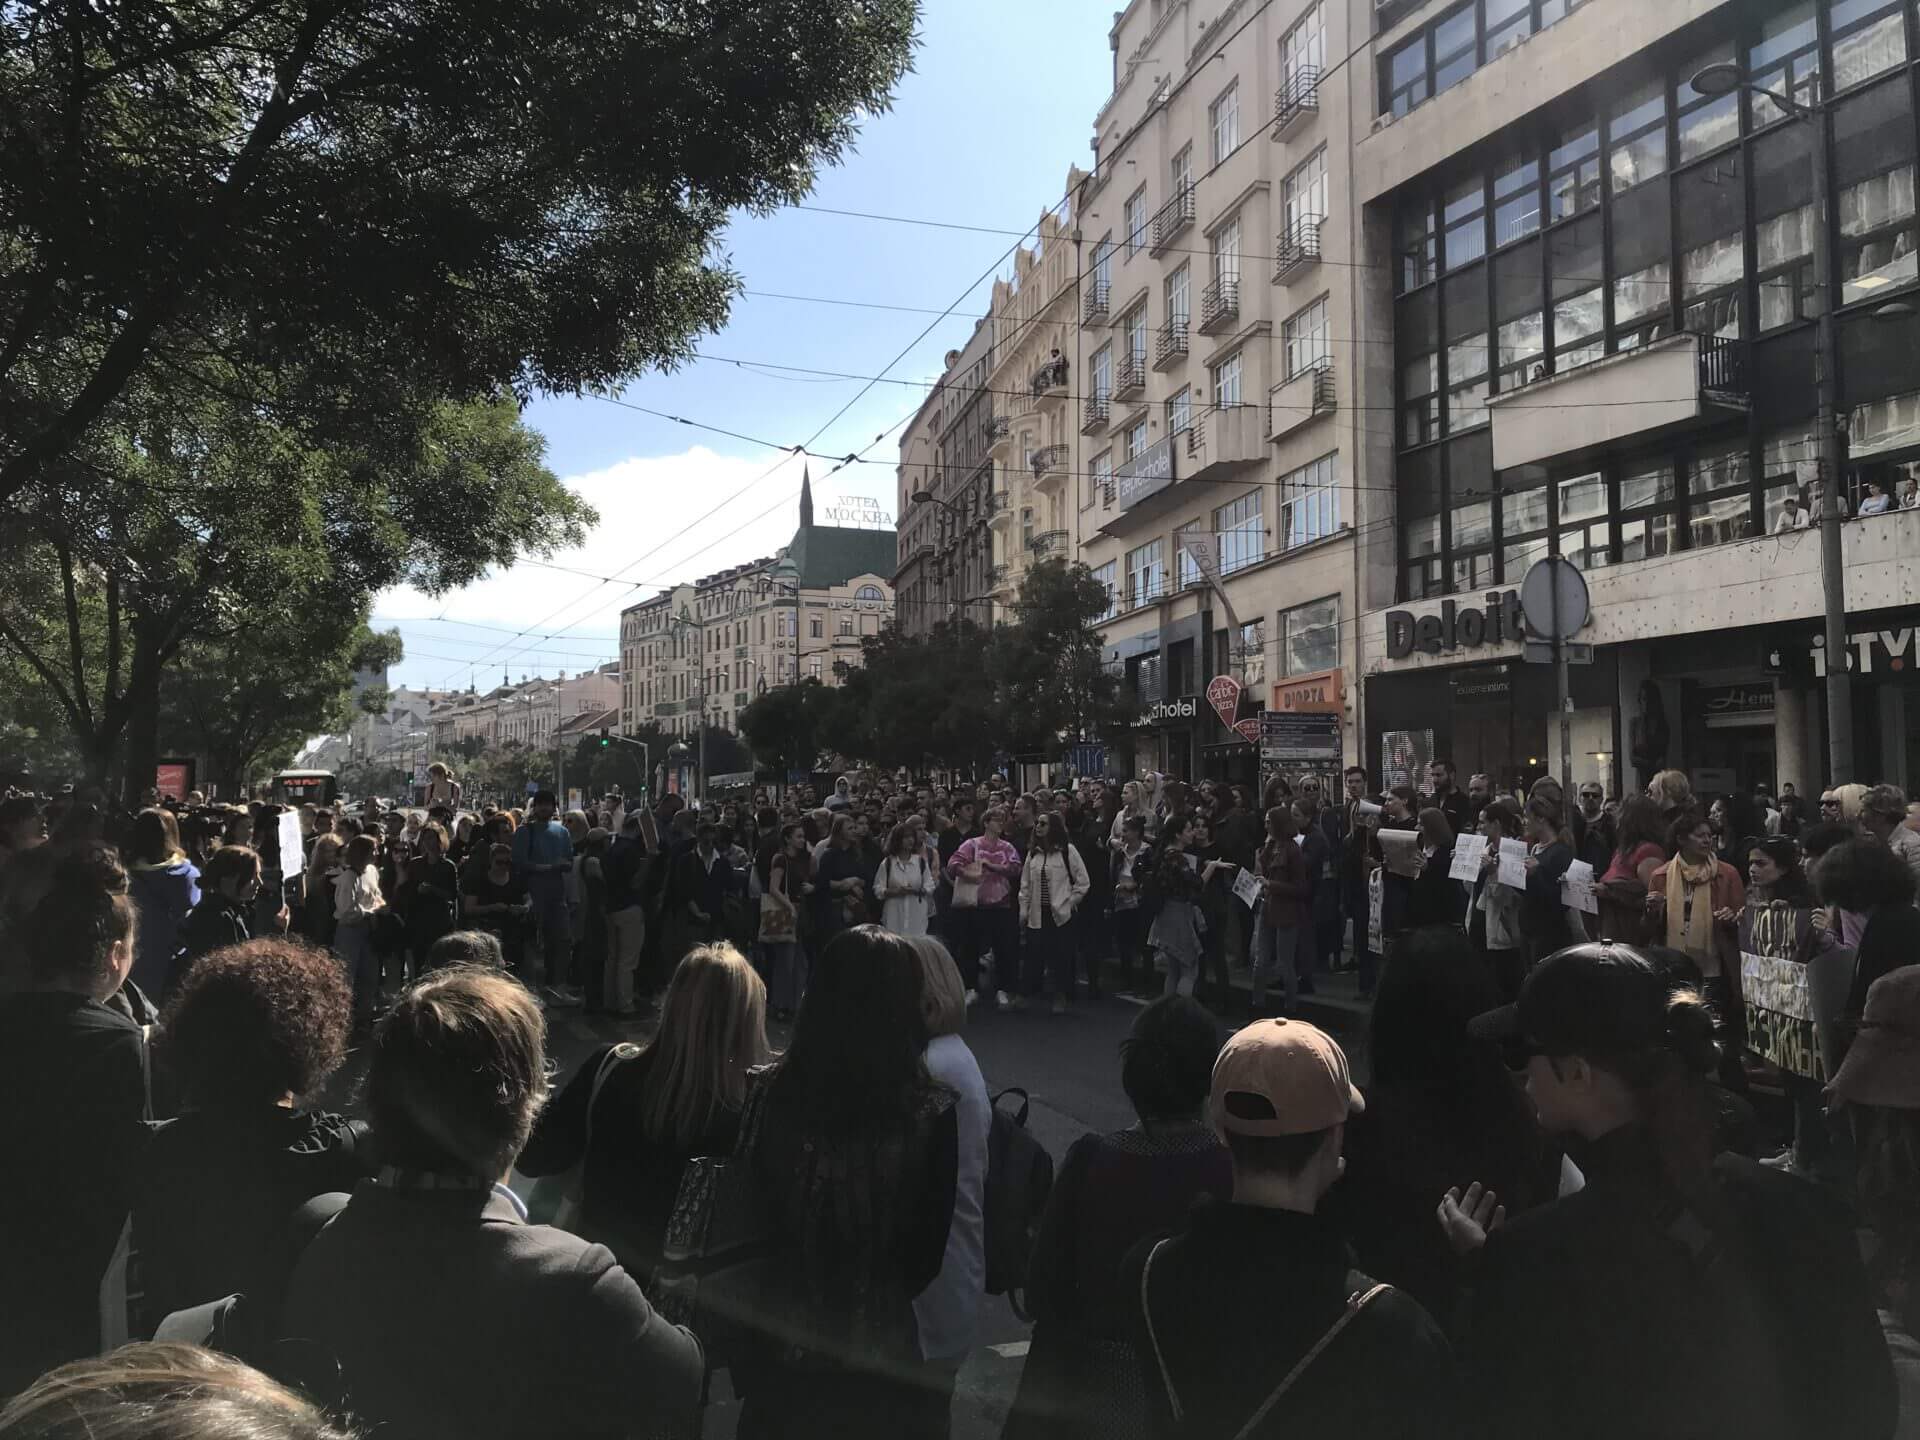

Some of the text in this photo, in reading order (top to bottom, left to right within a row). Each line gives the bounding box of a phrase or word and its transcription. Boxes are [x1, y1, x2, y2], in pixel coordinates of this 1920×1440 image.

[825, 507, 892, 524] МОСКВА
[1386, 589, 1527, 659] Deloit
[1810, 626, 1920, 678] iTY
